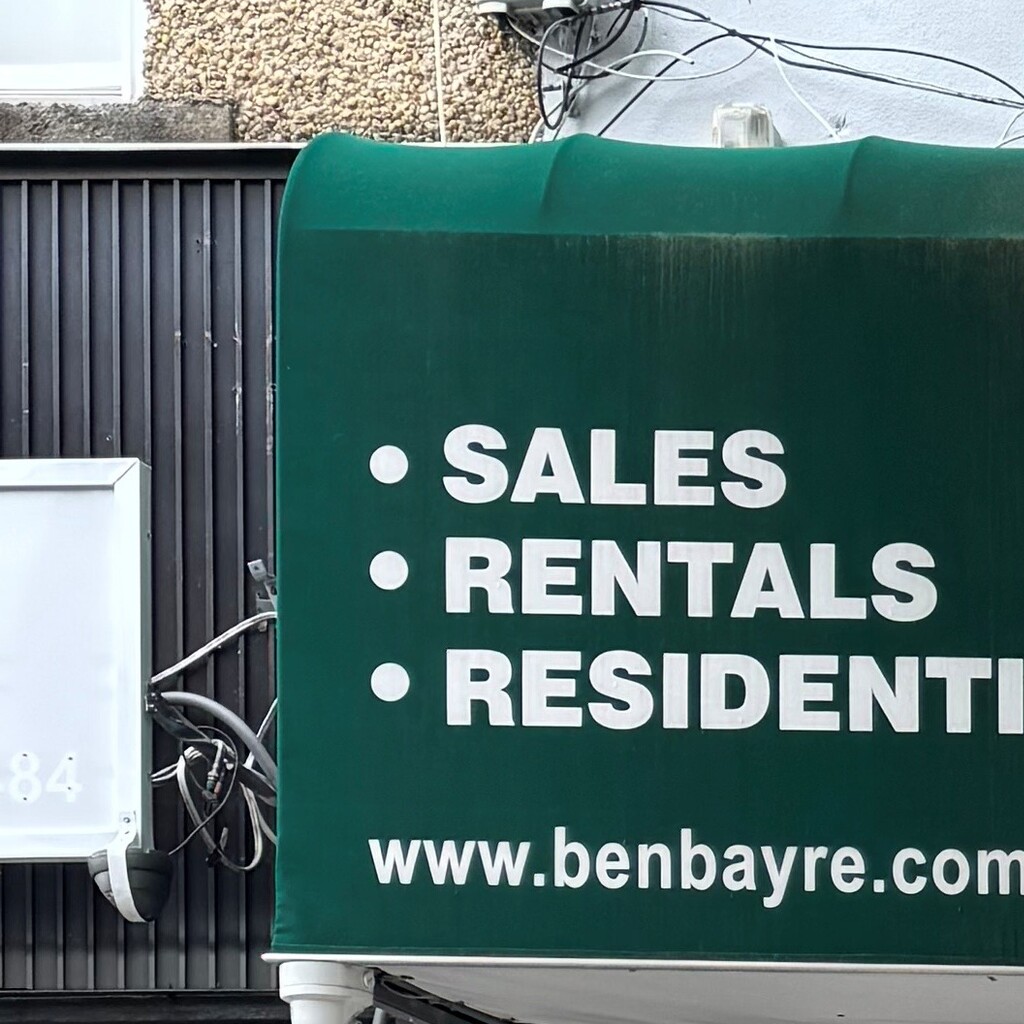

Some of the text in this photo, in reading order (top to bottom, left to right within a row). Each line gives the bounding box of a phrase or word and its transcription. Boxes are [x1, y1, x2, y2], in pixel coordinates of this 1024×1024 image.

[442, 423, 787, 509] SALES
[445, 536, 938, 622] RENTALS
[0, 750, 83, 805] 84
